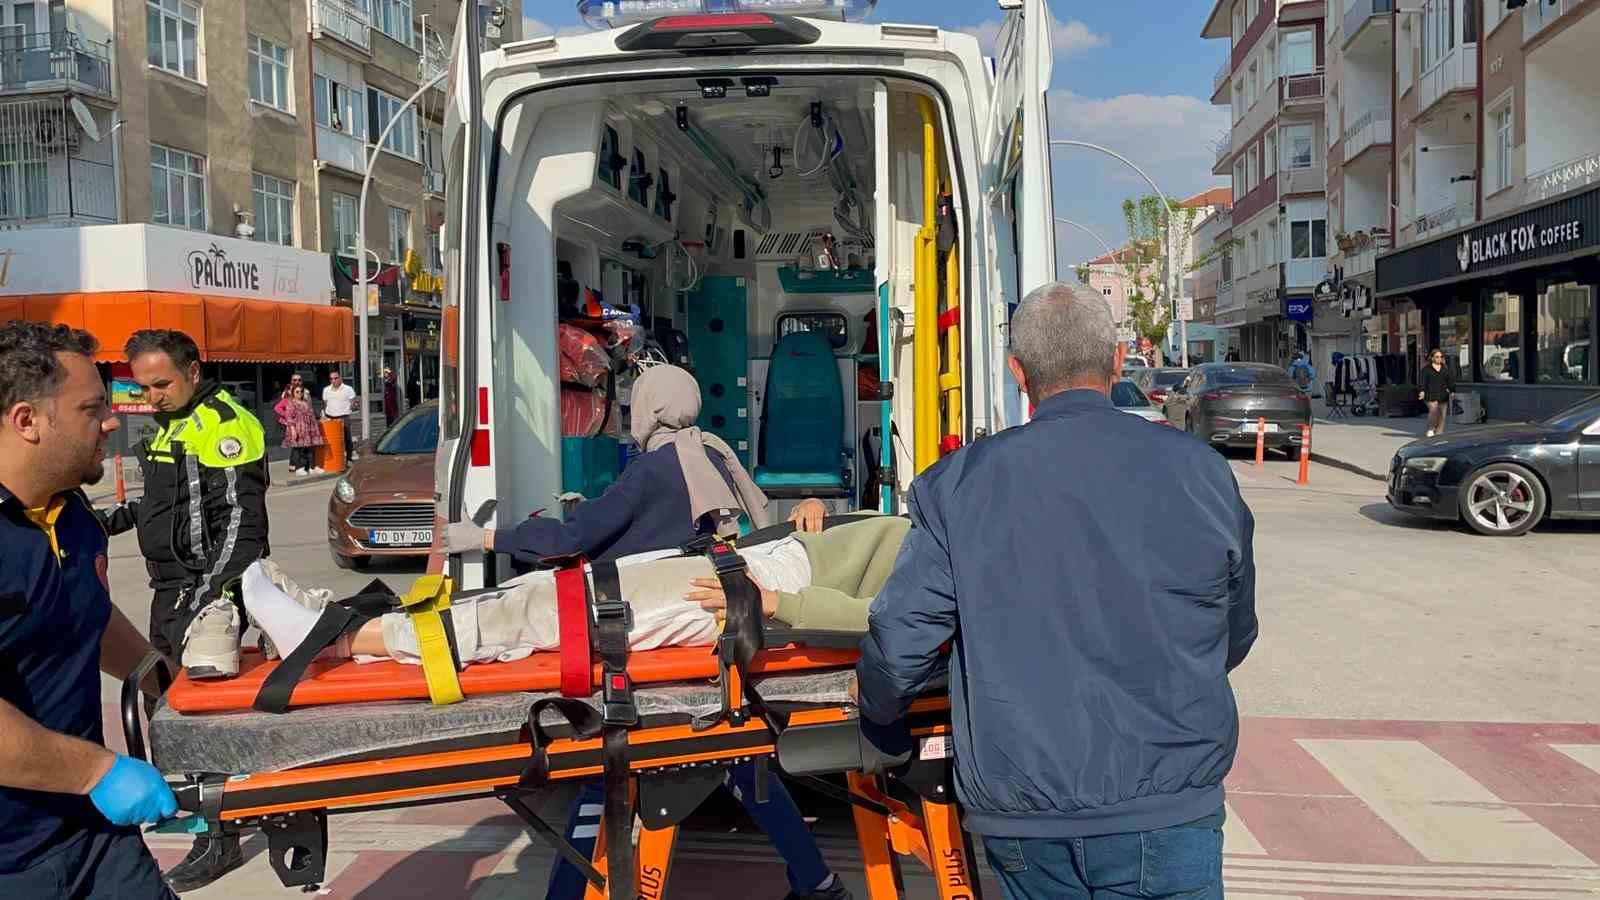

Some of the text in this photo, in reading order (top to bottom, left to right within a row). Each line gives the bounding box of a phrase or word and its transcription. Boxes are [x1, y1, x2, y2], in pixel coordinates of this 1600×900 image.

[1472, 220, 1580, 263] BLACK FOX COFFEE
[375, 531, 431, 542] 70 DY 700
[942, 847, 968, 888] PLUS
